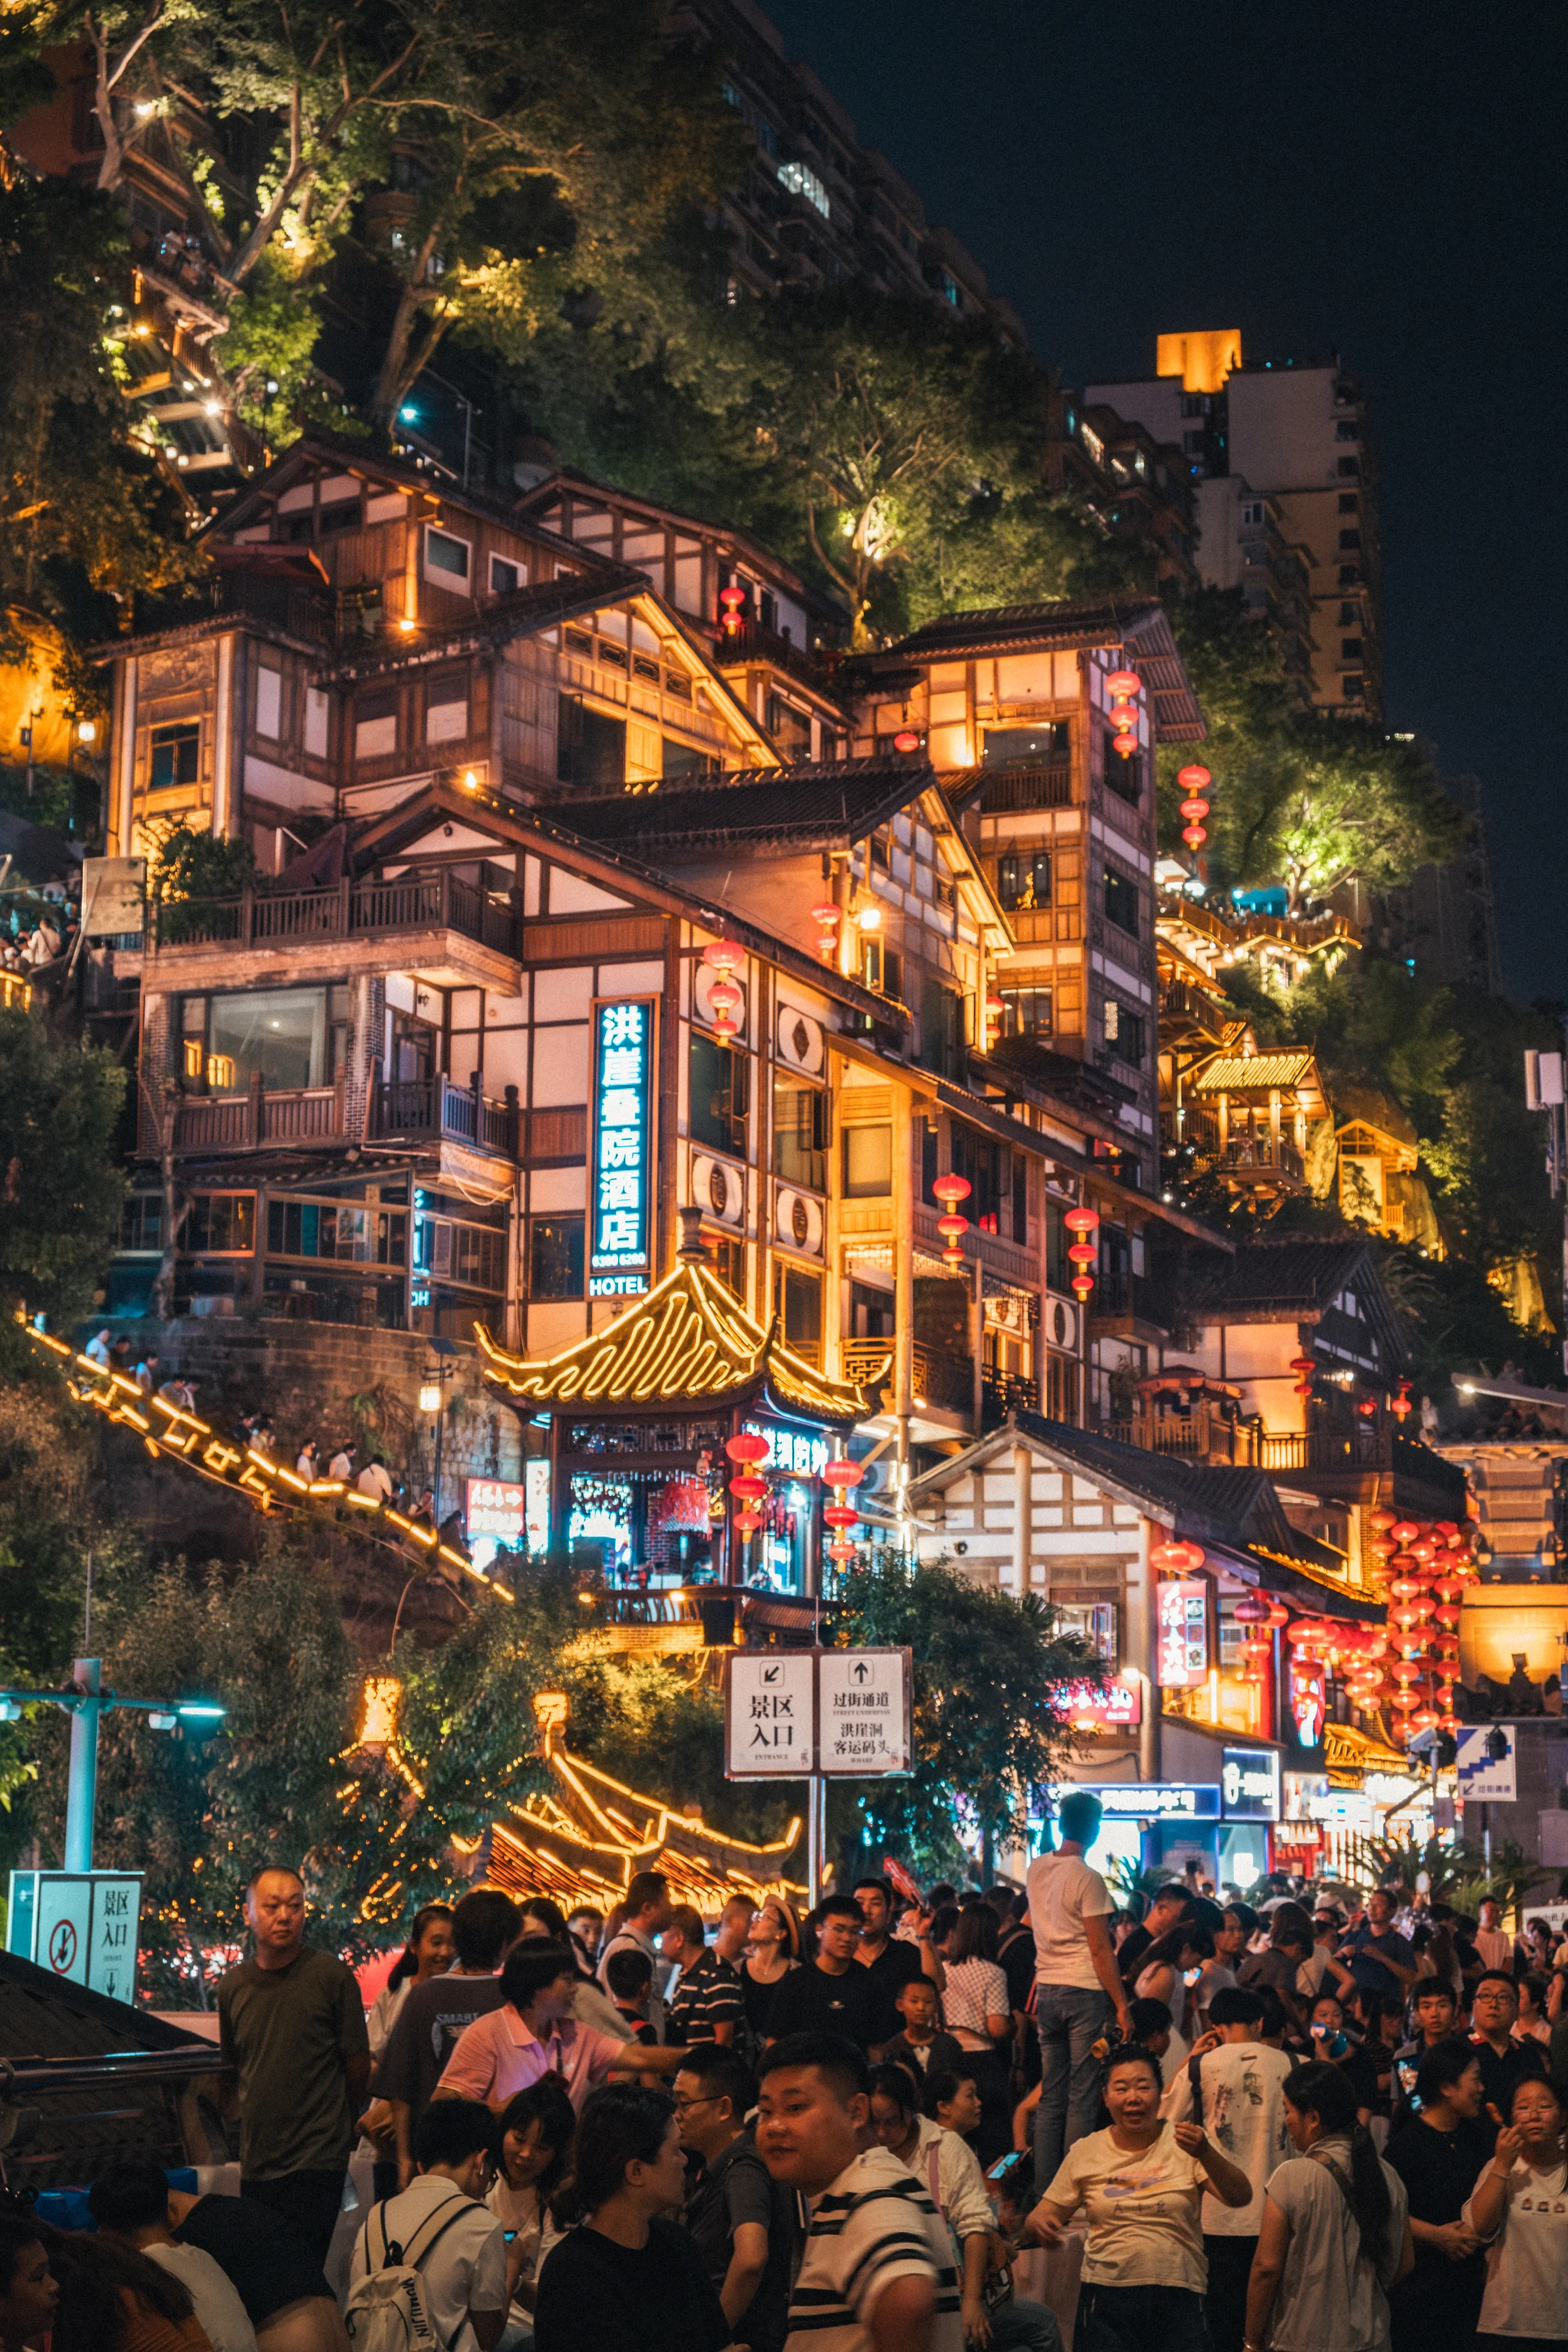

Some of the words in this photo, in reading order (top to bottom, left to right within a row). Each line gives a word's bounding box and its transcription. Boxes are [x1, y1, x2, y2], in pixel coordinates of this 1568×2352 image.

[599, 1005, 643, 1250] 洪崖叠院酒店
[589, 1275, 649, 1297] HOTEL
[749, 1694, 794, 1719] 景区
[833, 1692, 889, 1707] 过街通道
[748, 1723, 793, 1748] 入口
[841, 1723, 883, 1738] 洪崖洞
[834, 1740, 890, 1755] 客运码头
[103, 1890, 130, 1917] 景区
[101, 1921, 127, 1948] 入口
